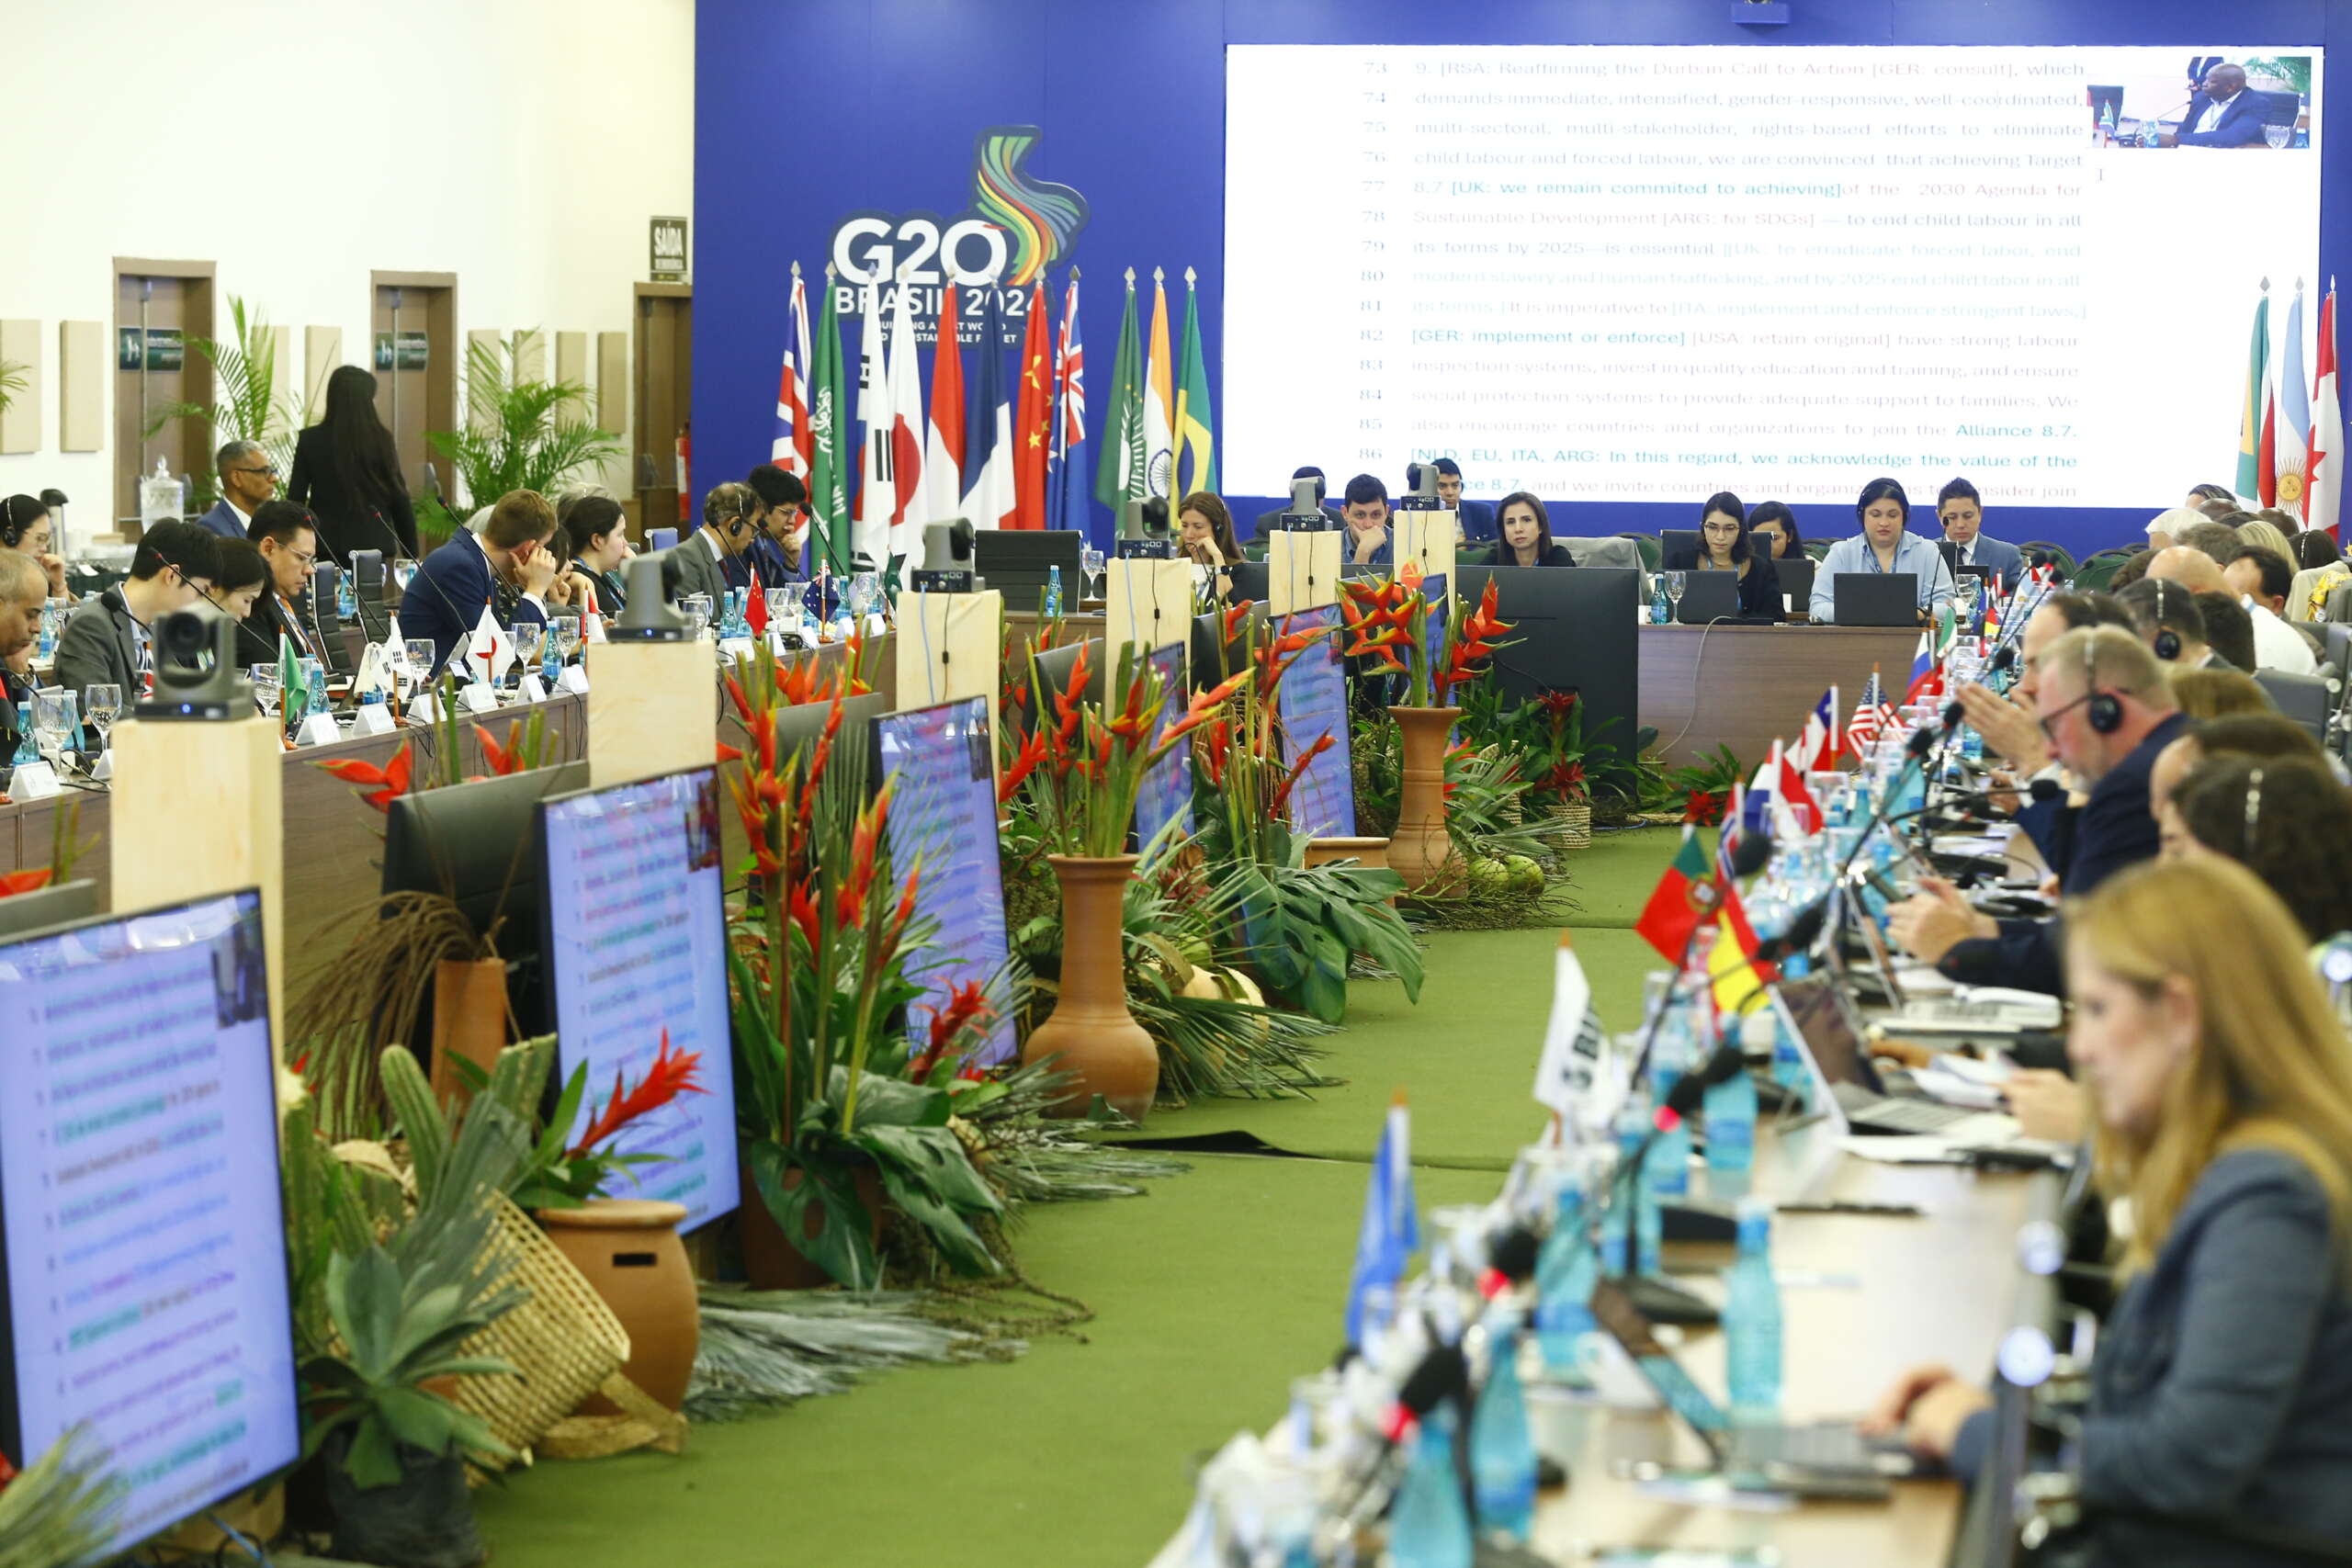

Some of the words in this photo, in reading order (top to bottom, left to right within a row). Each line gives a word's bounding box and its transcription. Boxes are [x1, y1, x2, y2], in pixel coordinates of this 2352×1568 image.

[1452, 182, 1491, 197] [UK:
[1499, 184, 1527, 193] we
[1536, 182, 1602, 194] remain
[1716, 183, 1735, 194] to
[833, 218, 1007, 287] G20
[965, 288, 1046, 316] 22
[1412, 331, 1464, 345] [GER:
[1473, 331, 1573, 345] implement
[1581, 333, 1600, 343] or
[1607, 332, 1685, 346] enforce]
[1955, 424, 2032, 436] Alliance
[2041, 425, 2078, 437] 8.7.
[1472, 450, 1502, 463] EU,
[1511, 450, 1544, 464] ITA,
[1554, 451, 1600, 462] ARG:
[1610, 451, 1625, 463] In
[1635, 452, 1668, 463] this
[1679, 452, 1742, 467] regard,
[1752, 455, 1779, 464] we
[1787, 453, 1911, 468] acknowledge
[1920, 455, 1951, 466] the
[1959, 455, 2010, 467] value
[2020, 456, 2038, 467] of
[2046, 456, 2077, 468] the
